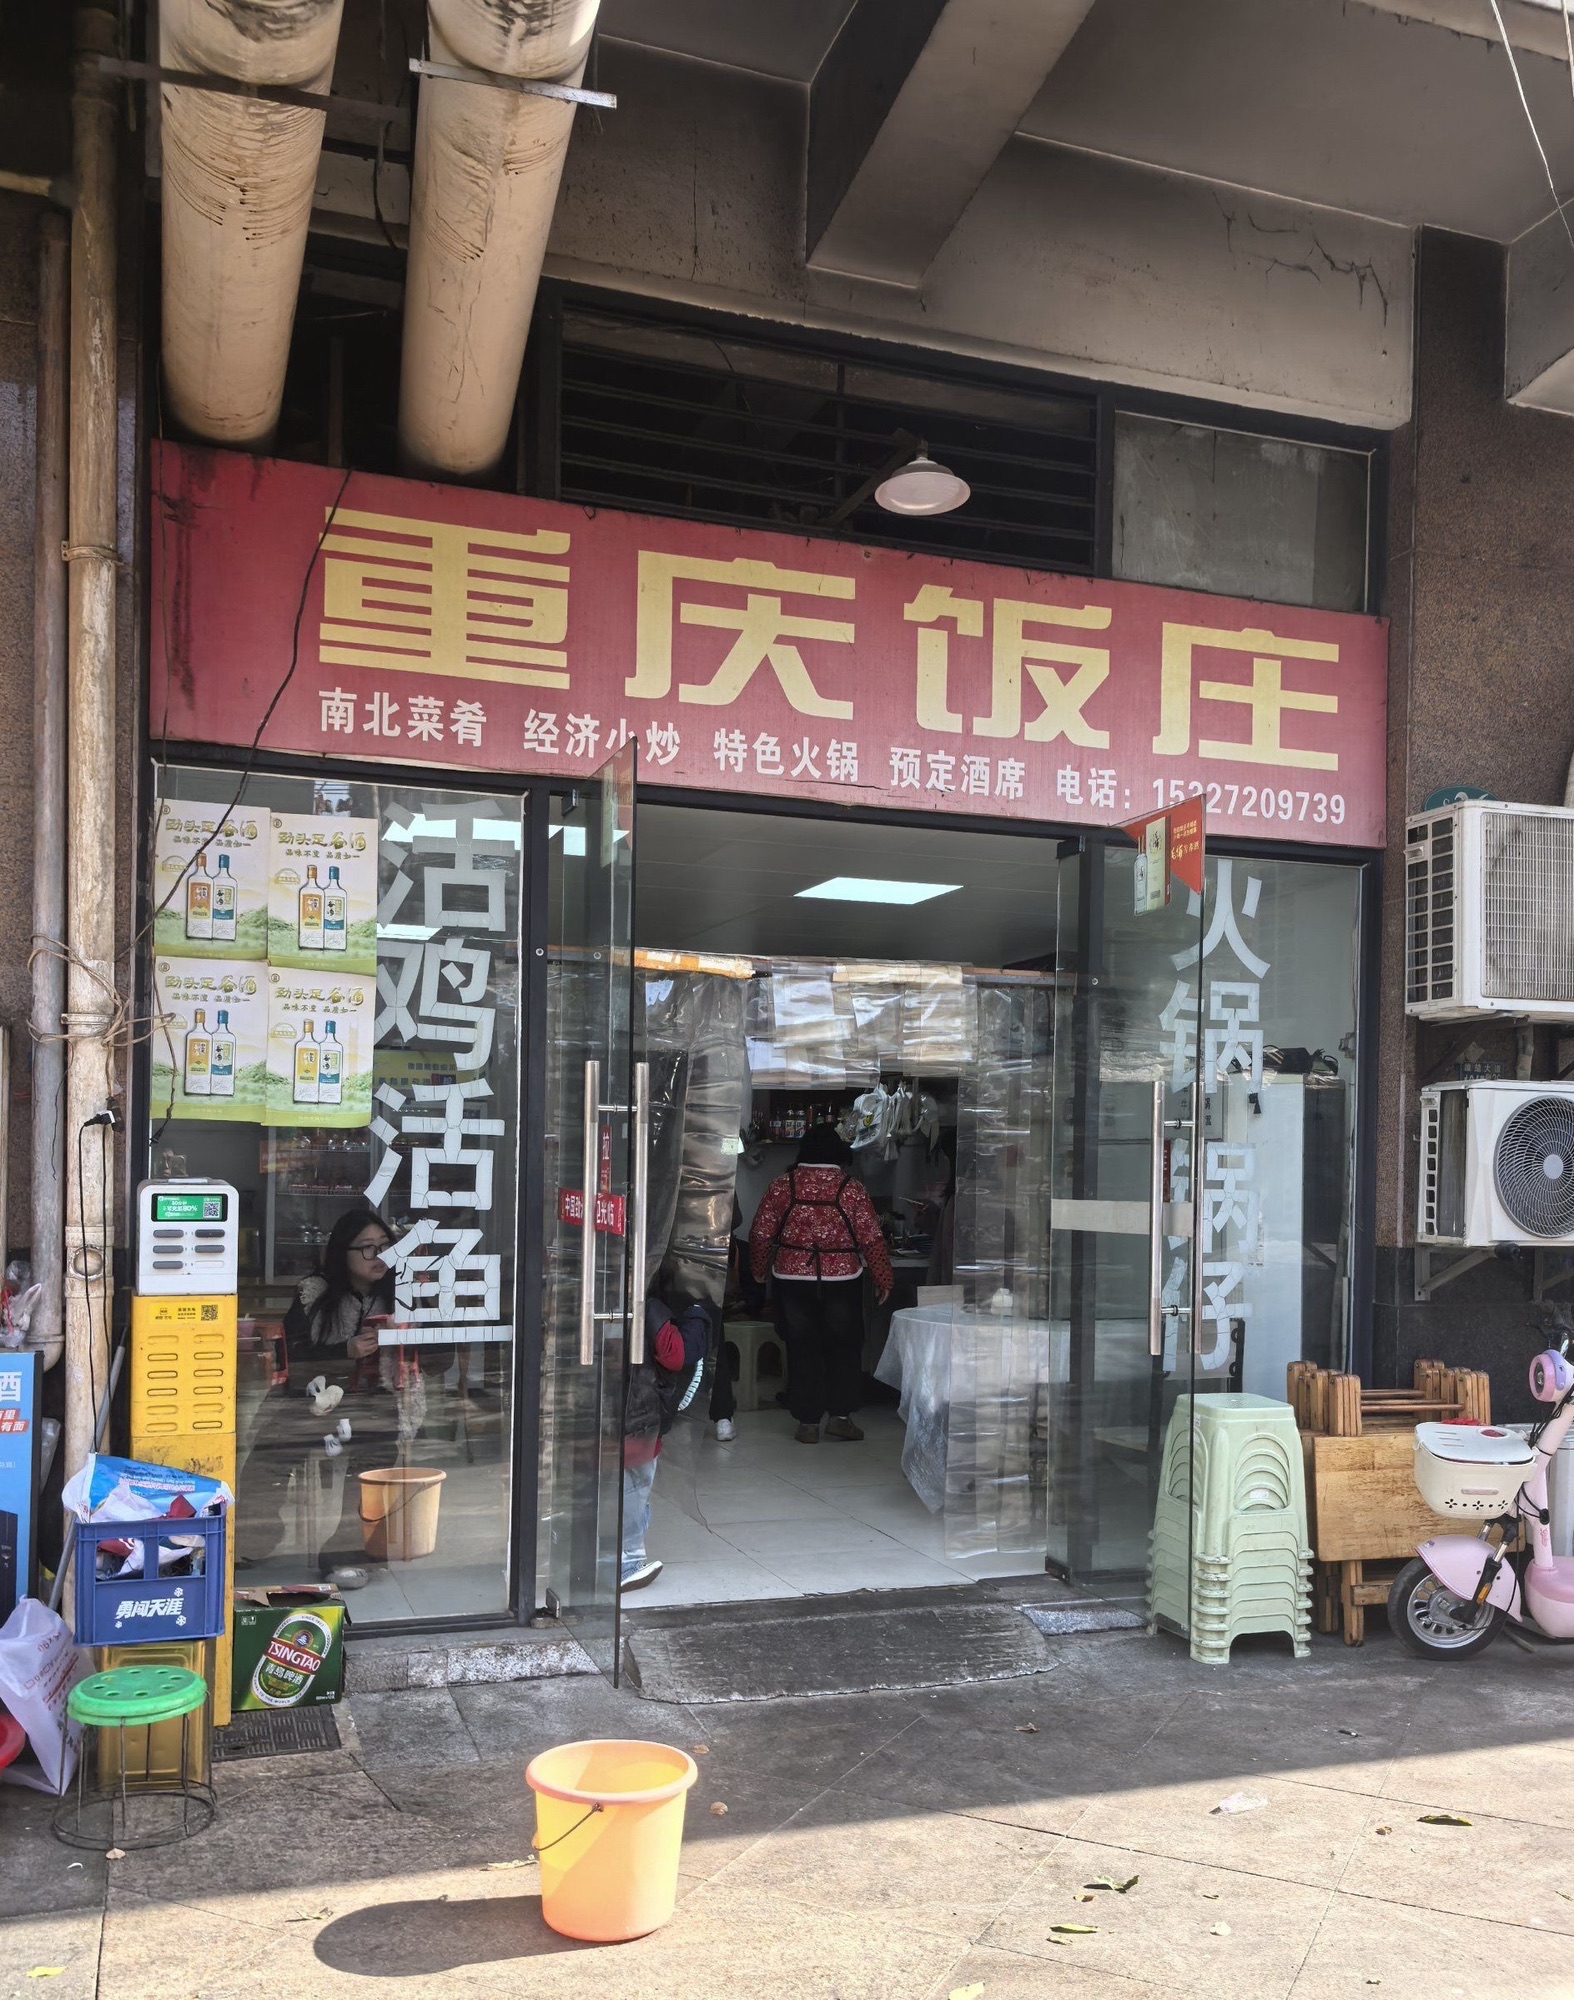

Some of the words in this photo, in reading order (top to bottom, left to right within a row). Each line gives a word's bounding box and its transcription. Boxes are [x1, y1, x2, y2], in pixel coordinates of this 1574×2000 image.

[318, 506, 1340, 772] 重庆饭庄
[318, 687, 488, 749] 南北菜肴
[523, 708, 681, 766] 经济小炒
[712, 728, 859, 784] 特色火锅
[889, 746, 1026, 800] 预定酒席
[363, 800, 514, 1346] 活鸡活鱼
[114, 1598, 184, 1619] 勇闯天涯
[268, 1640, 321, 1671] TSINGTAO
